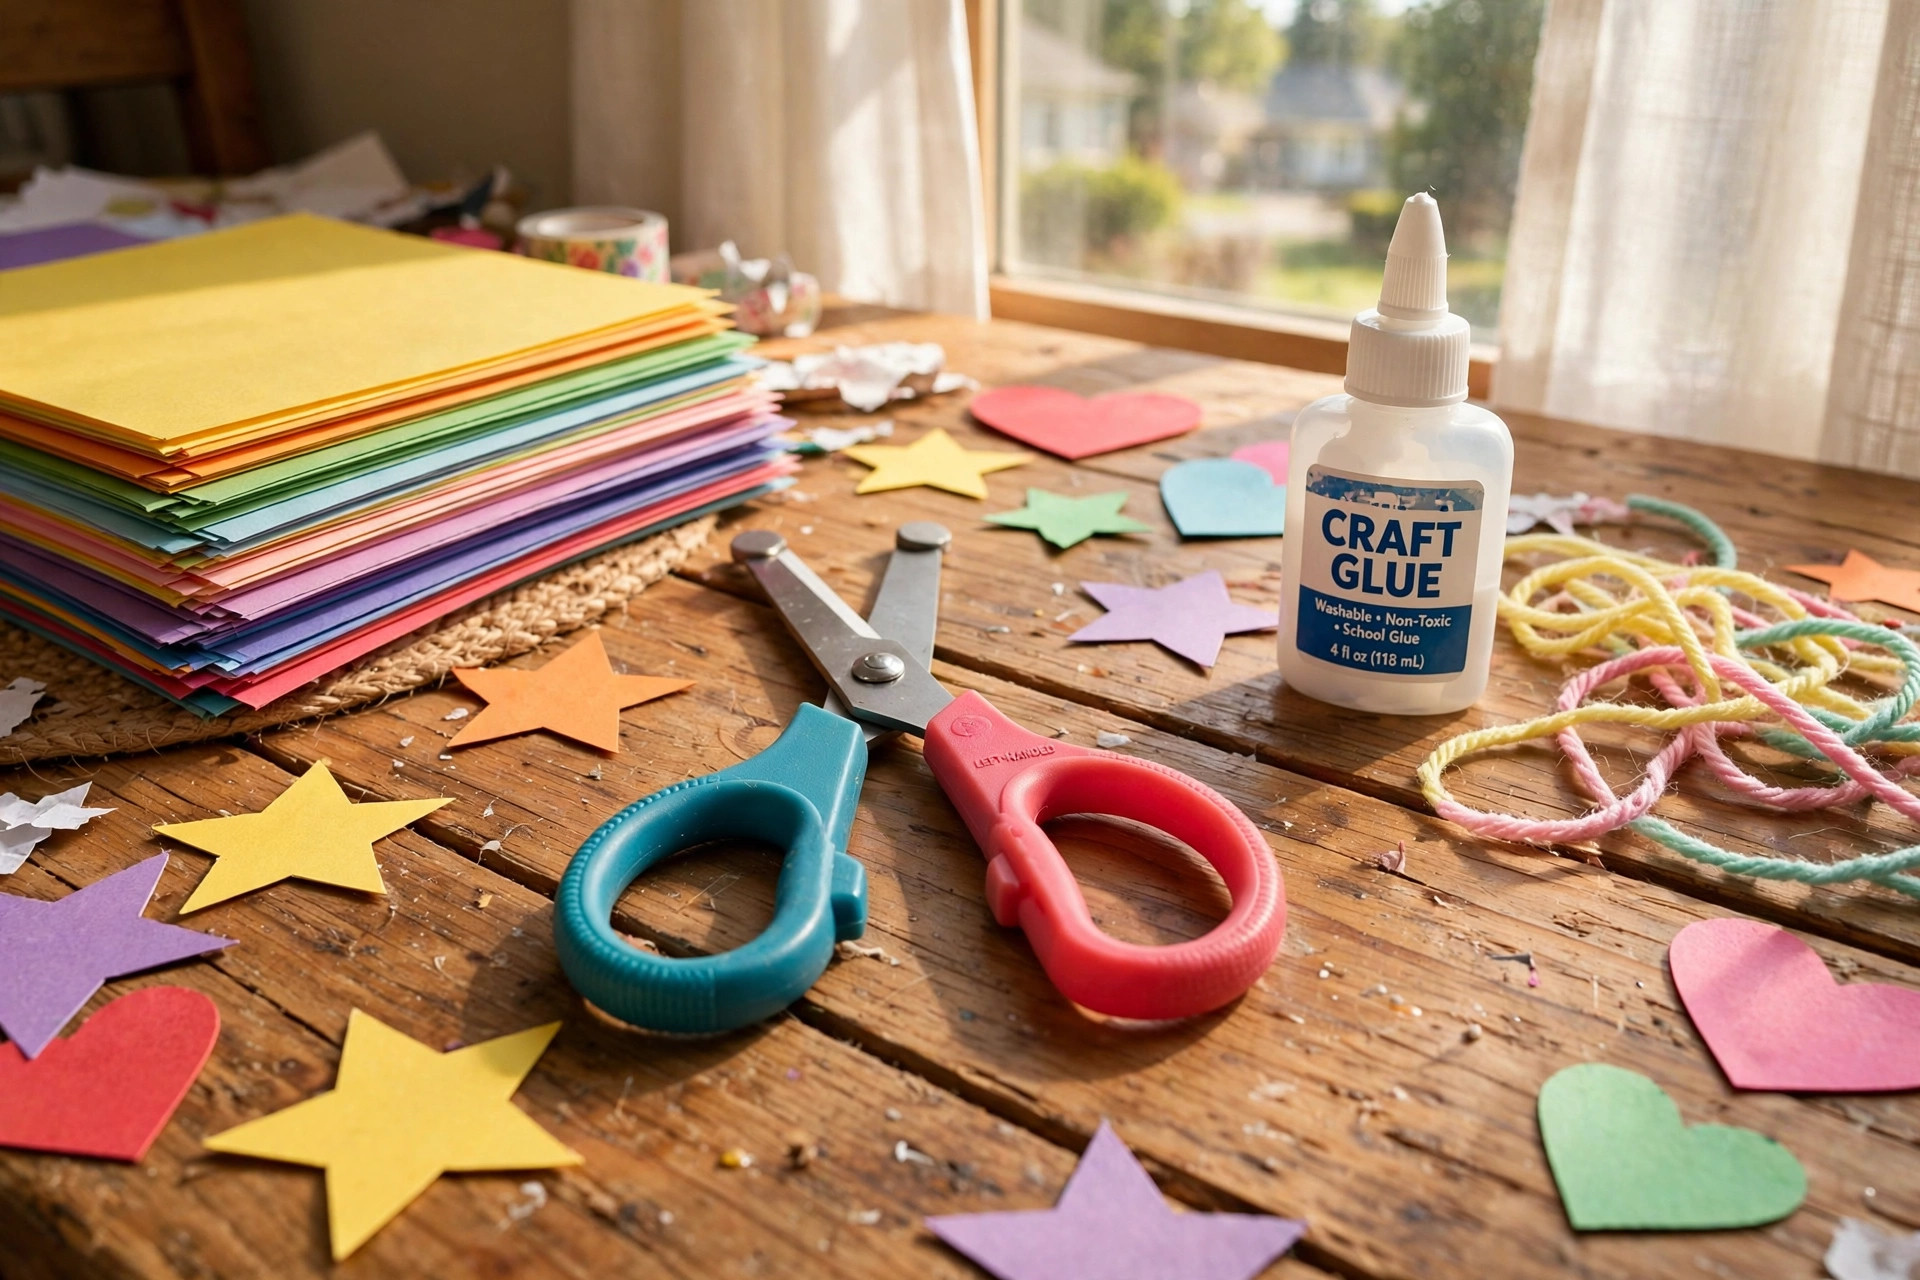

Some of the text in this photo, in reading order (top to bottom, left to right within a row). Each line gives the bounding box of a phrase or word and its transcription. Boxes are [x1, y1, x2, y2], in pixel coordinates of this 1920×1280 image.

[1322, 509, 1462, 557] CRAFT
[1331, 553, 1442, 598] GLUE
[1315, 598, 1451, 627] Washable Non-Toxic
[1343, 623, 1420, 644] School Glue
[1330, 644, 1424, 669] 4 fl oz (118 mL)
